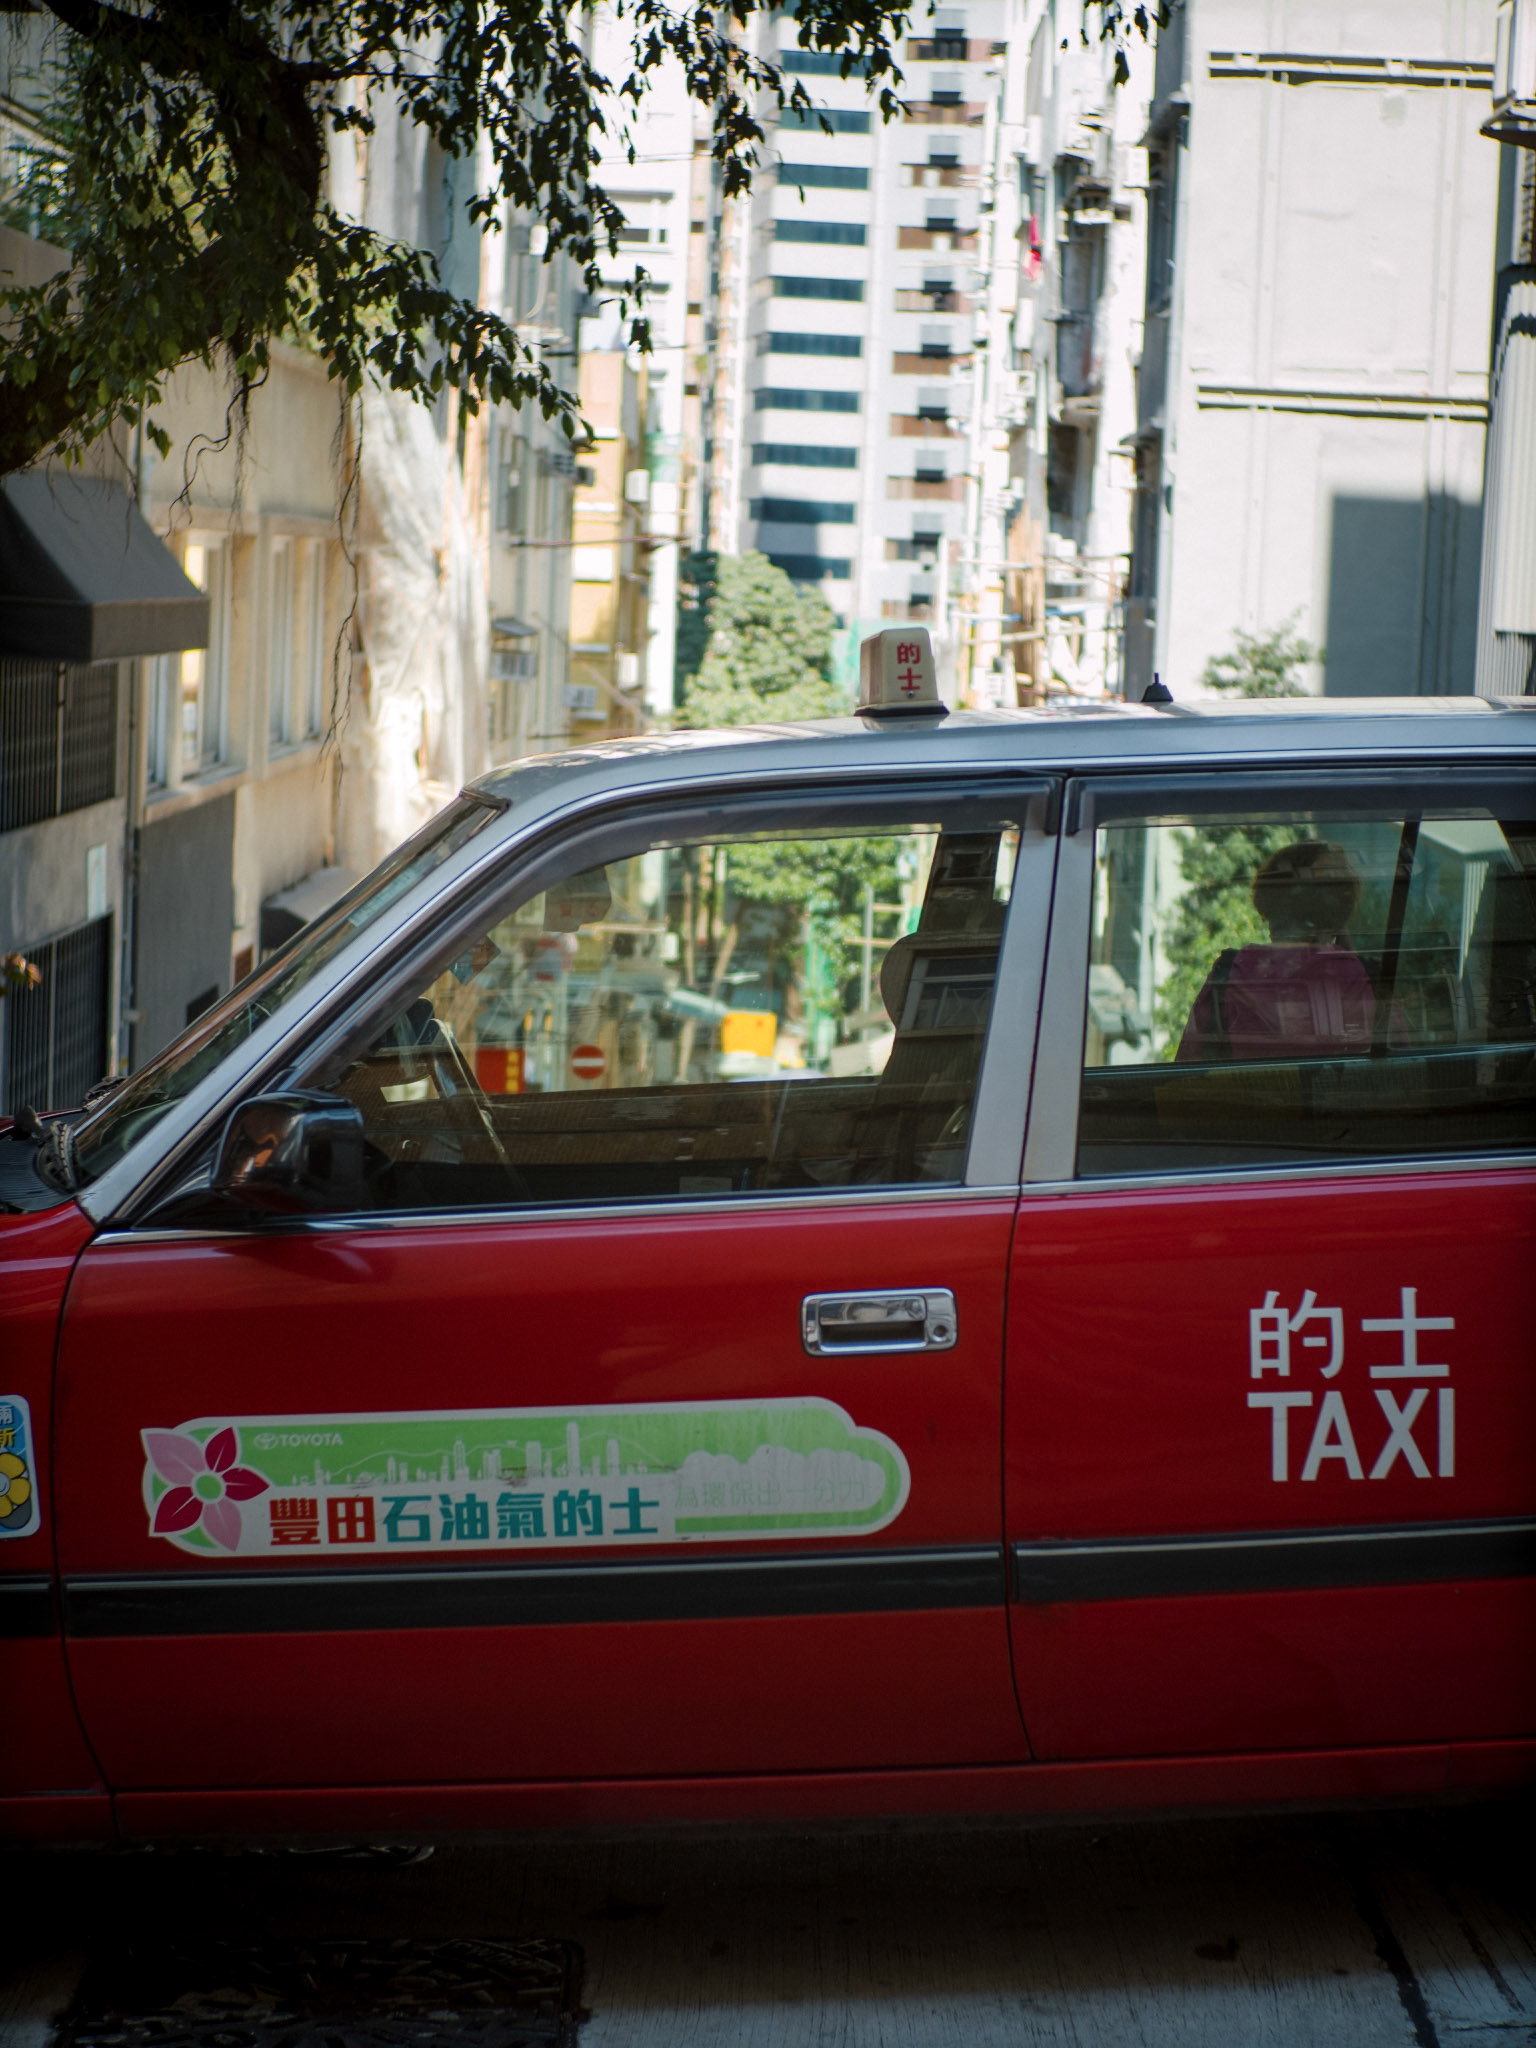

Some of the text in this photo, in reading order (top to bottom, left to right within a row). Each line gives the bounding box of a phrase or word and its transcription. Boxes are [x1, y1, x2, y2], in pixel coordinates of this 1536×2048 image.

[897, 642, 923, 692] 的士
[1249, 1287, 1455, 1379] 的士
[280, 1432, 344, 1448] TOYOTA
[1247, 1388, 1455, 1482] TAXI
[269, 1487, 660, 1546] 豐田石油氣的士
